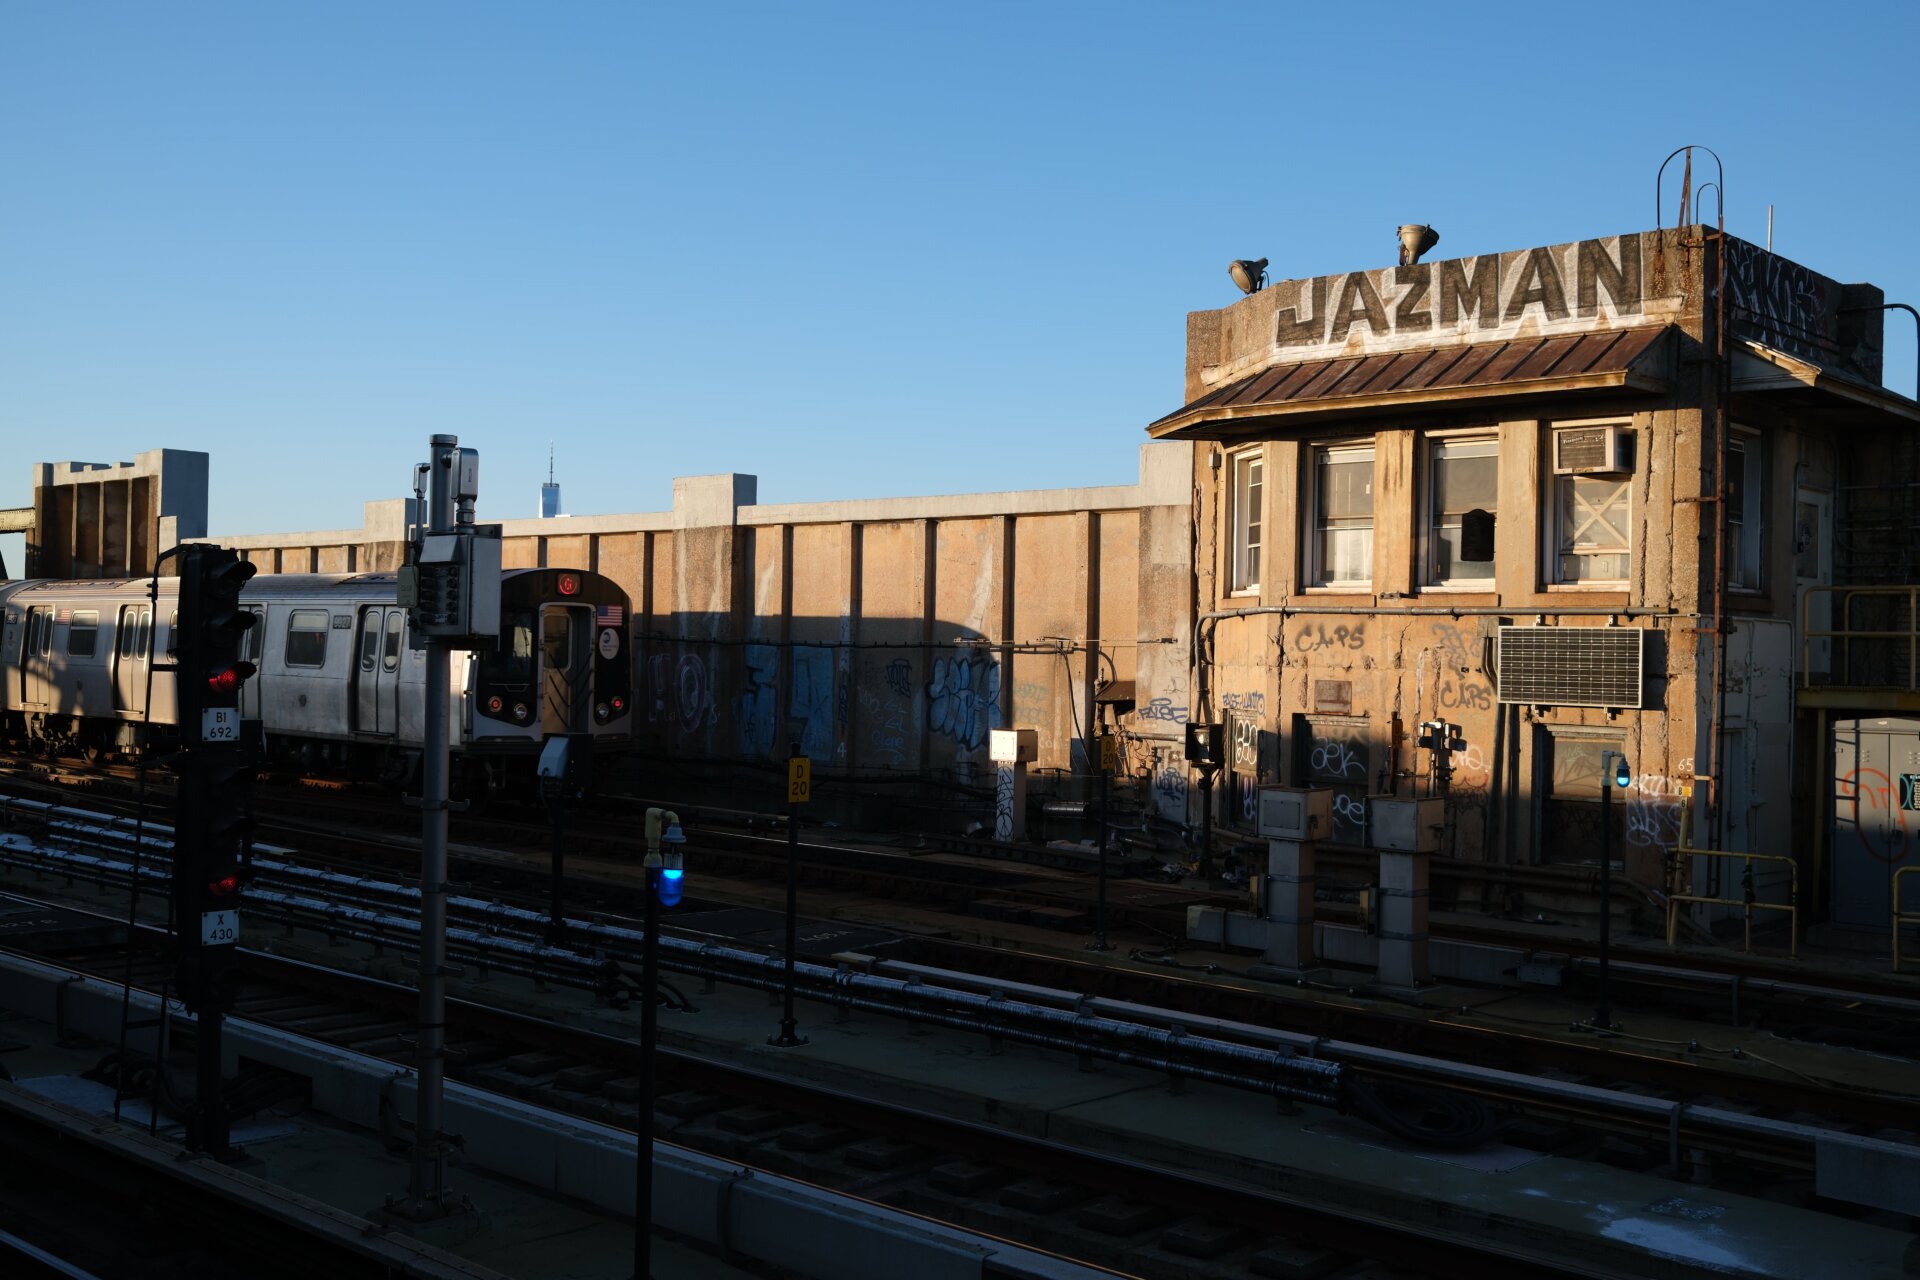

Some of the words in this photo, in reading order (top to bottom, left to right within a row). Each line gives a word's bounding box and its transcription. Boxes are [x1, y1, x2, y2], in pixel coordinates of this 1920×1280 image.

[1274, 232, 1643, 348] JAZMAN
[1294, 623, 1365, 651] CAPS
[1440, 680, 1493, 710] CAPS
[210, 726, 232, 738] 692
[1102, 753, 1114, 765] 20
[1678, 757, 1694, 772] 65
[796, 764, 804, 779] D
[791, 781, 808, 796] 20
[217, 914, 225, 925] X
[210, 928, 233, 941] 430
